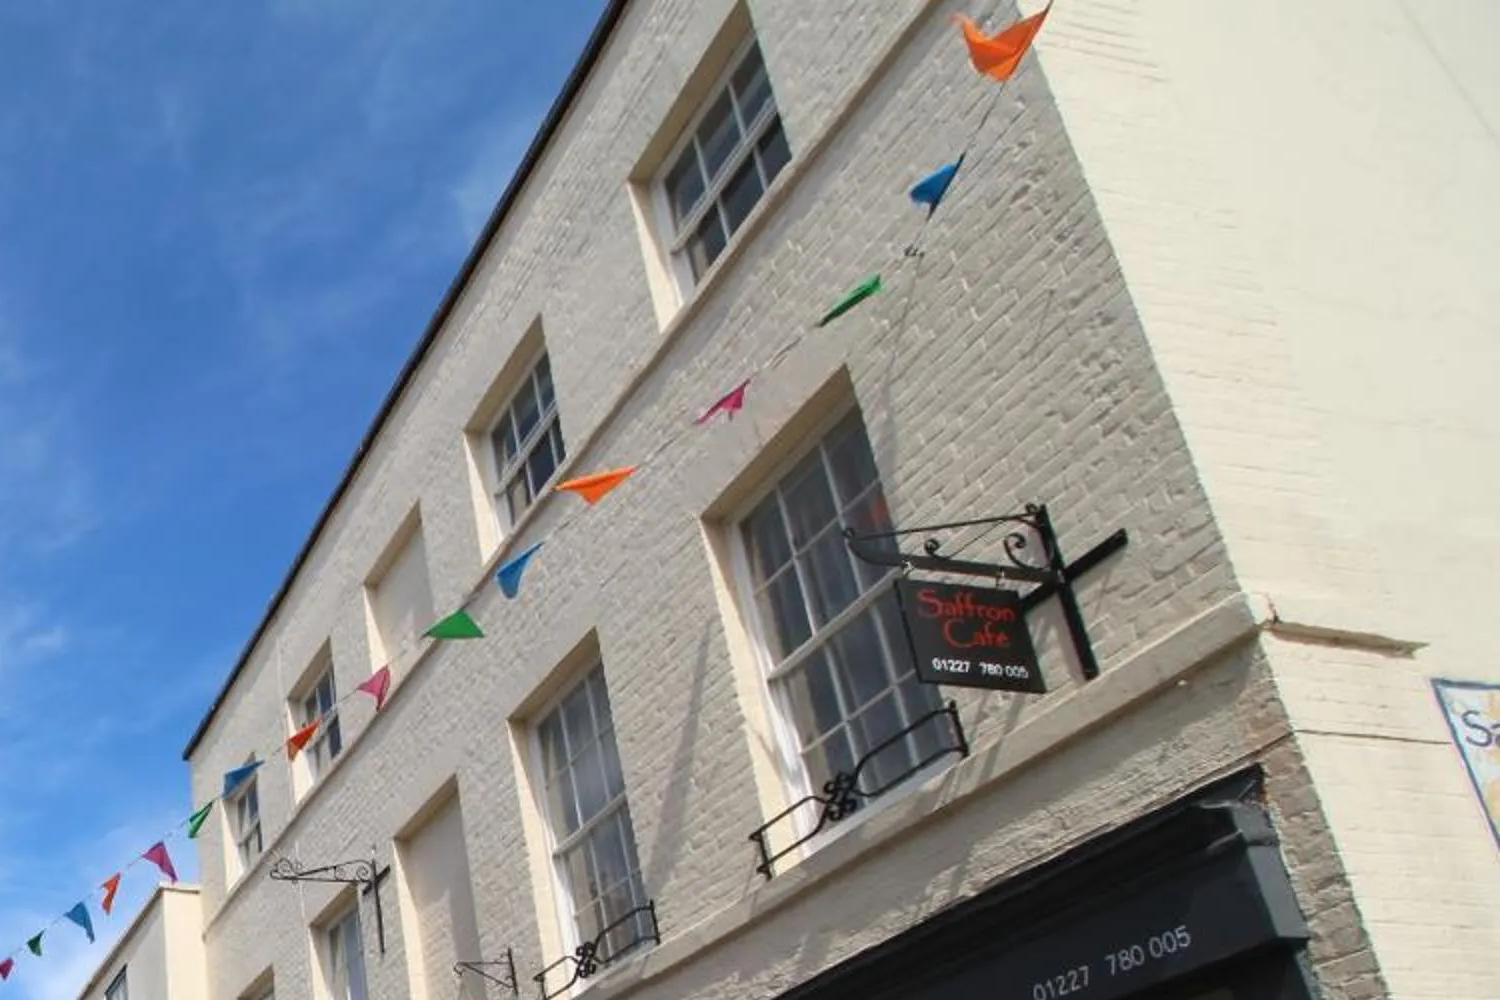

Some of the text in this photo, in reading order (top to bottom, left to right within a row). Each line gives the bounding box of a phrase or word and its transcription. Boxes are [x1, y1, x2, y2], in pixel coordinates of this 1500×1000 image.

[916, 587, 1016, 621] Saffron
[931, 657, 971, 673] 01227
[978, 661, 1003, 677] 780
[1460, 708, 1500, 747] S
[1104, 944, 1145, 977] 780
[1148, 924, 1192, 958] 005
